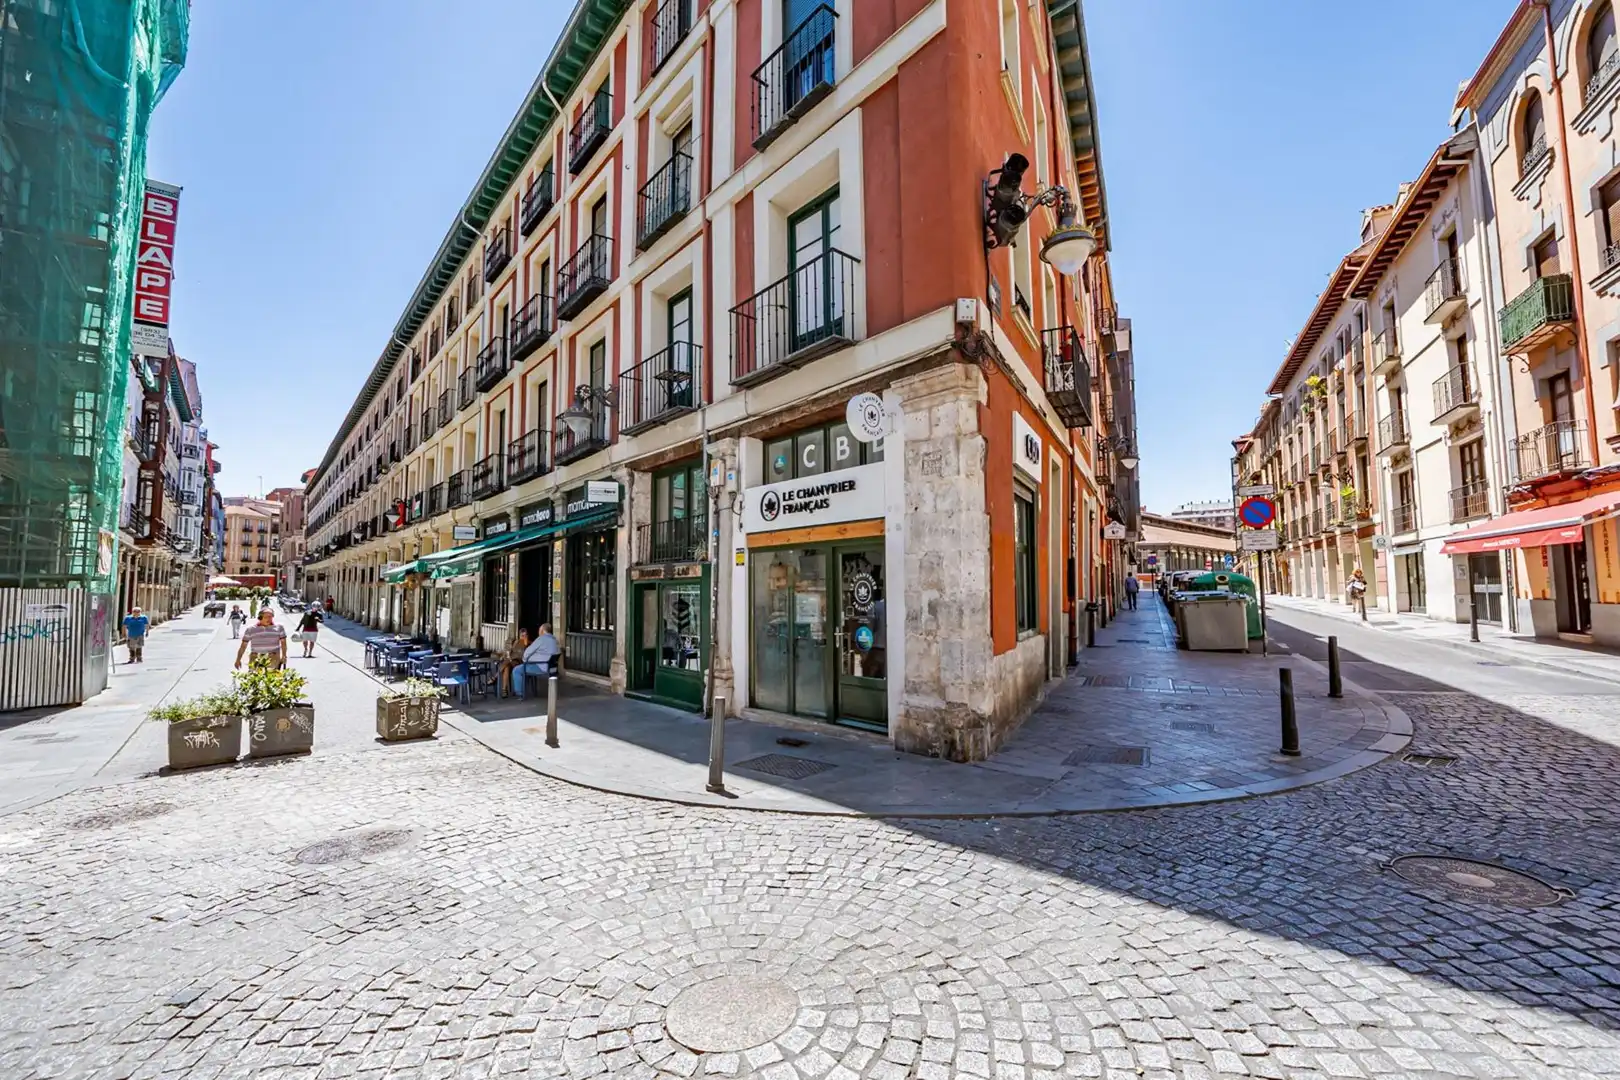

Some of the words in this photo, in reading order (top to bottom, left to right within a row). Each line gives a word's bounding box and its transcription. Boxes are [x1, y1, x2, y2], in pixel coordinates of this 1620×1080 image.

[138, 197, 174, 318] BLAPE
[783, 490, 794, 501] LE
[797, 480, 856, 498] CHANVRIER
[783, 498, 829, 514] FRANÇAIS
